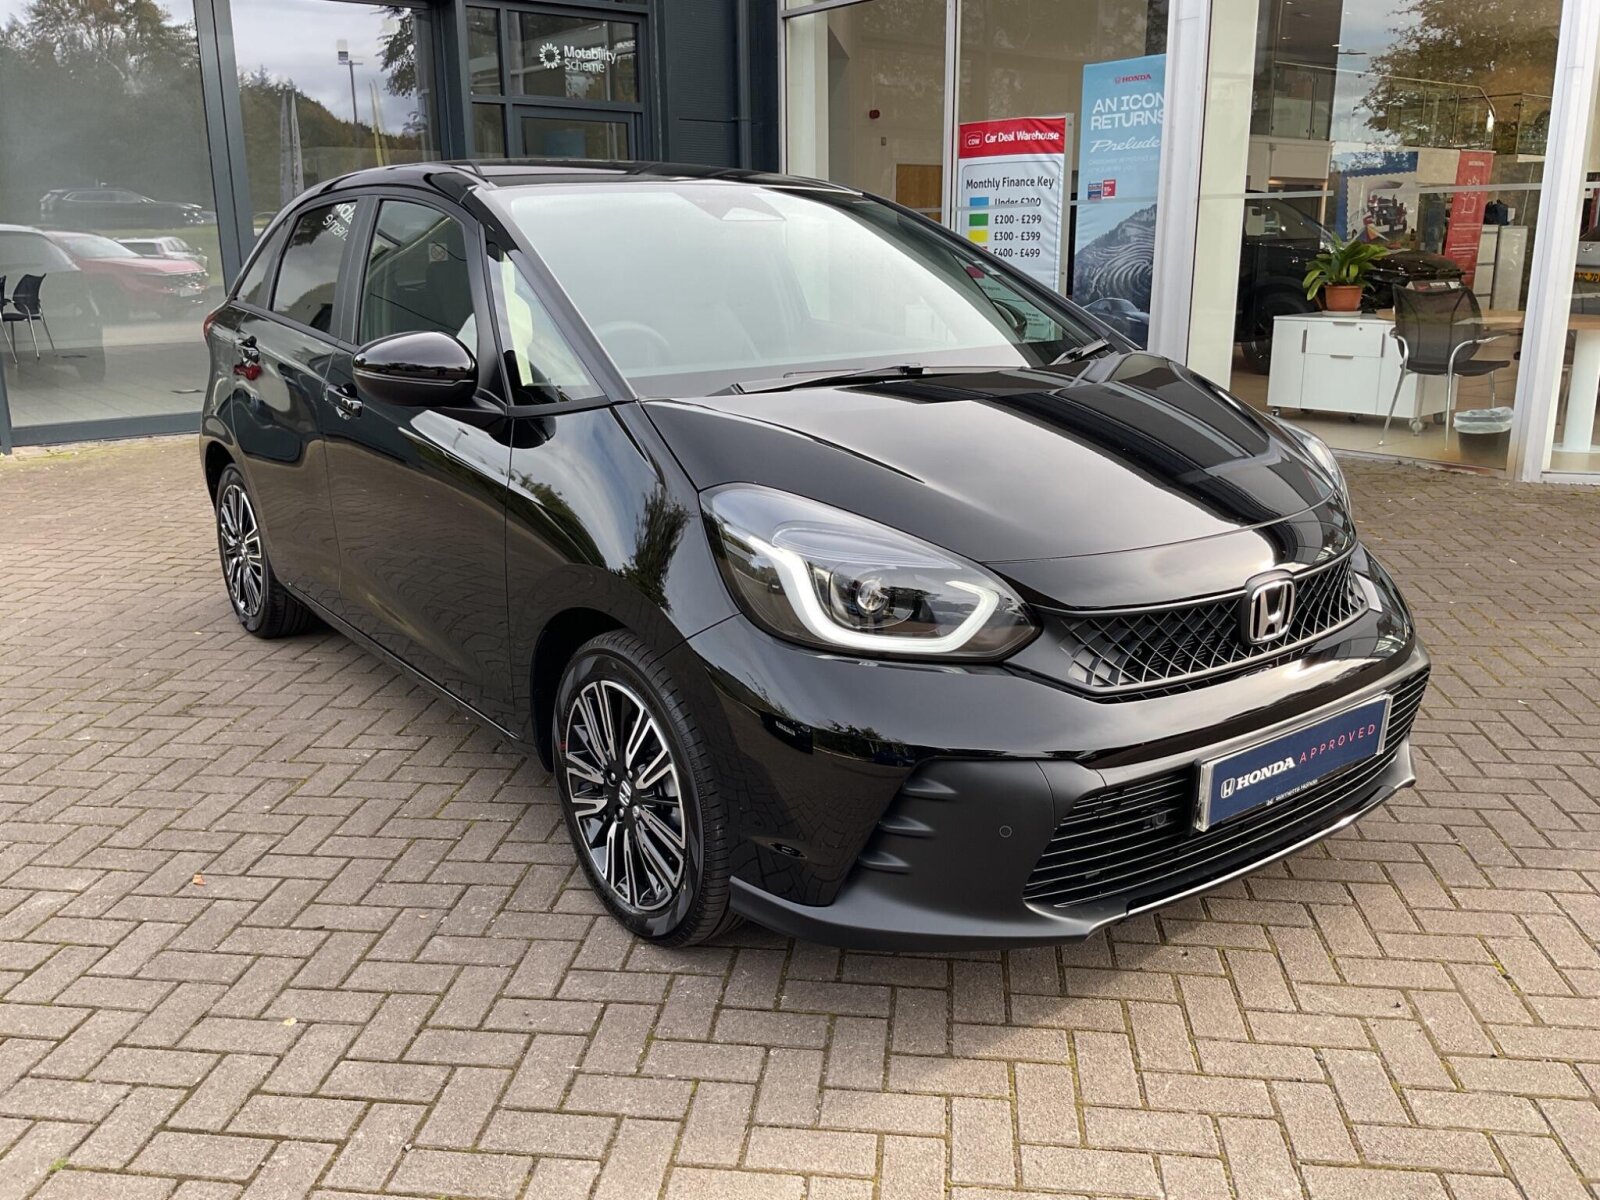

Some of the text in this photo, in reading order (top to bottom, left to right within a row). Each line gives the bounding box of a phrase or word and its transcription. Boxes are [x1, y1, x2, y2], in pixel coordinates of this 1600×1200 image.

[563, 45, 617, 64] Motability
[564, 58, 605, 73] Scheme
[1122, 73, 1152, 83] HONDA
[1092, 92, 1165, 114] AN ICON
[984, 130, 1060, 144] Car Deal Warehouse
[1089, 136, 1160, 153] Prelude
[966, 176, 1055, 191] Monthly Finance Key
[994, 214, 1015, 225] £200
[1021, 214, 1042, 225] £299
[994, 231, 1014, 241] £300
[1020, 231, 1041, 241] £399
[993, 248, 1013, 257] £400
[1020, 248, 1041, 257] £499
[1236, 756, 1296, 791] HONDA
[1299, 723, 1376, 764] APPROVED
